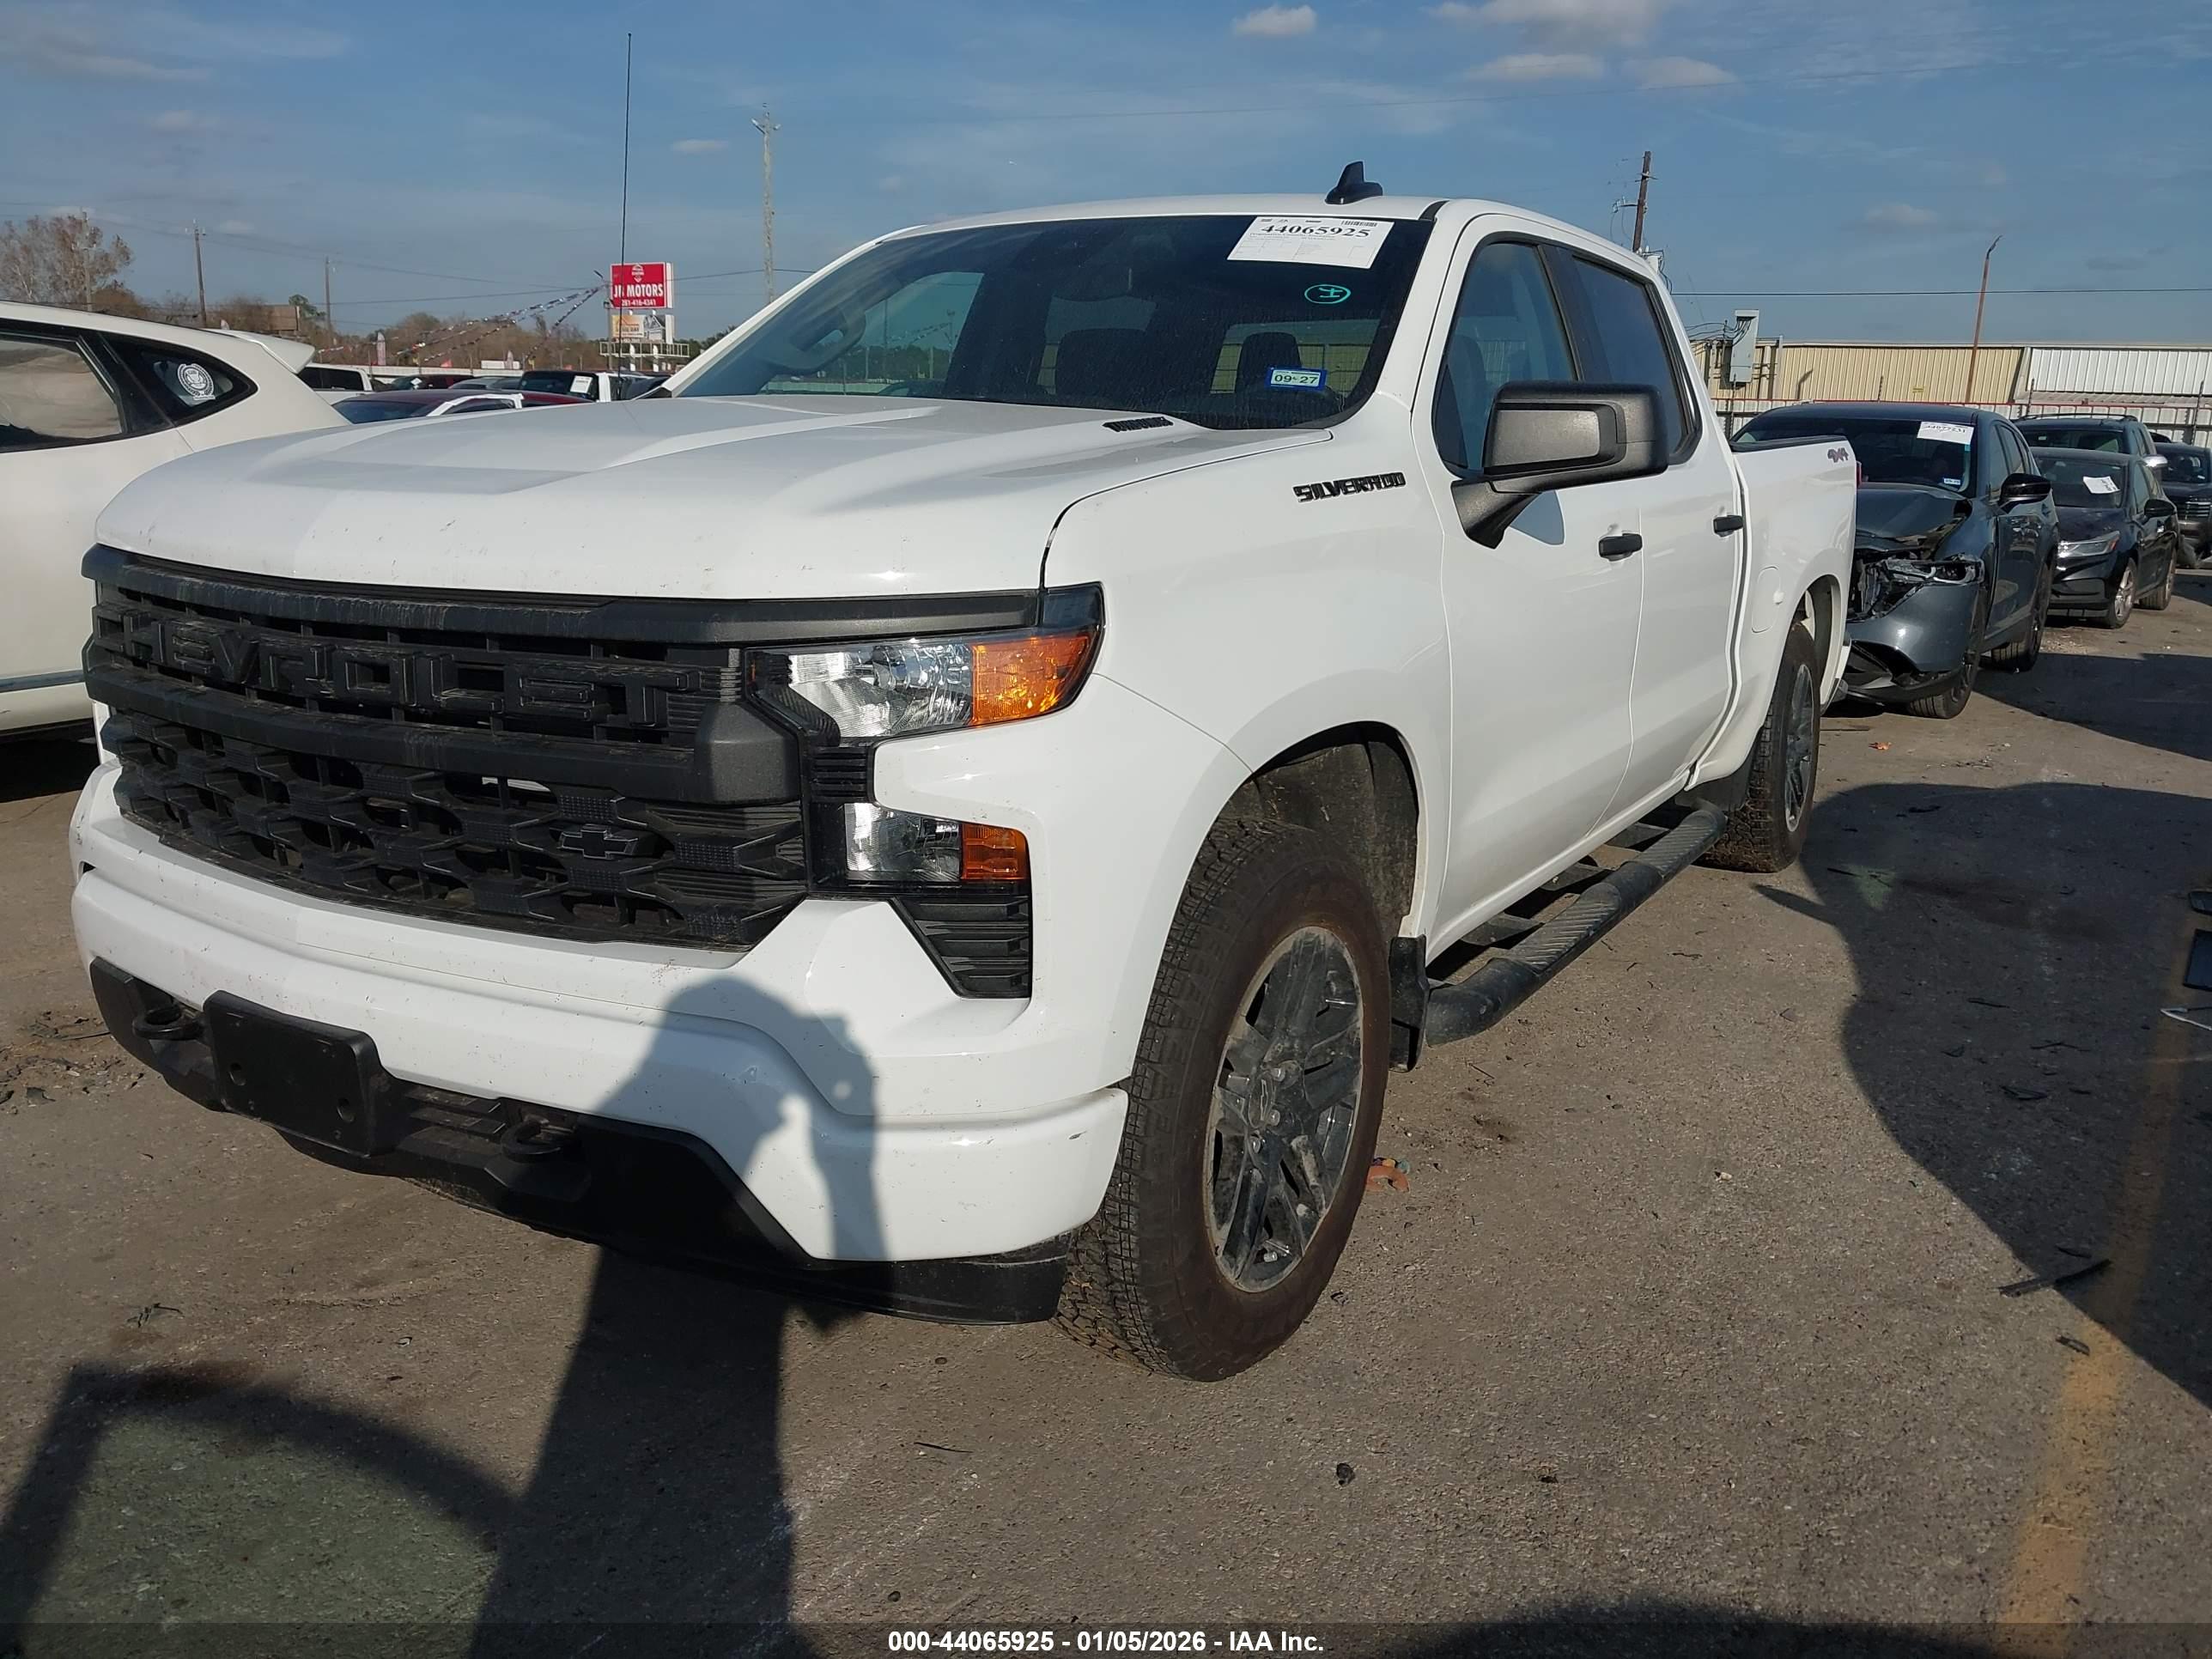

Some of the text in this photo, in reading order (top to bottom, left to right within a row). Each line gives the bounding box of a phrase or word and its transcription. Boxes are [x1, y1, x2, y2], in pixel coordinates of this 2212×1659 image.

[1261, 224, 1370, 238] 44065925
[626, 283, 663, 297] MOTORS
[1293, 471, 1407, 503] SILVERADO
[93, 607, 702, 728] CHEVROLET
